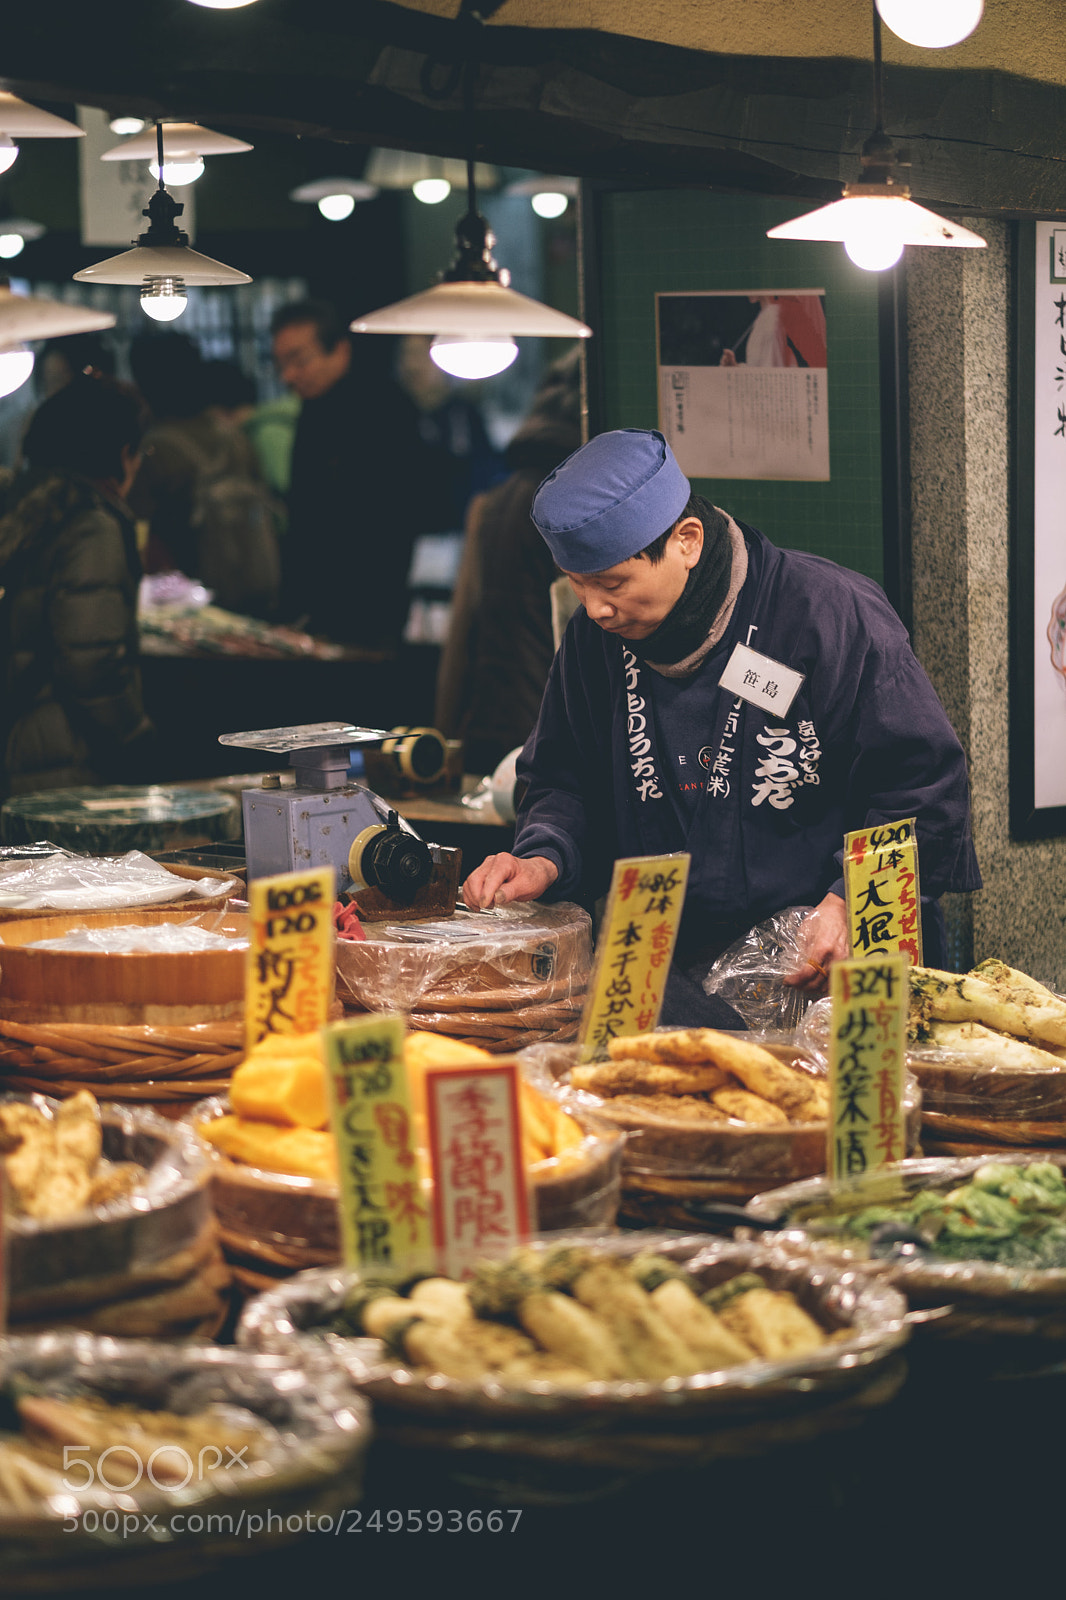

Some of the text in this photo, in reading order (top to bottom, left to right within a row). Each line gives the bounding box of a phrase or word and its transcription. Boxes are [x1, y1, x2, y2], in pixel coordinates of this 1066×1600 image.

[742, 669, 779, 699] 笹島
[750, 725, 804, 810] うちだ
